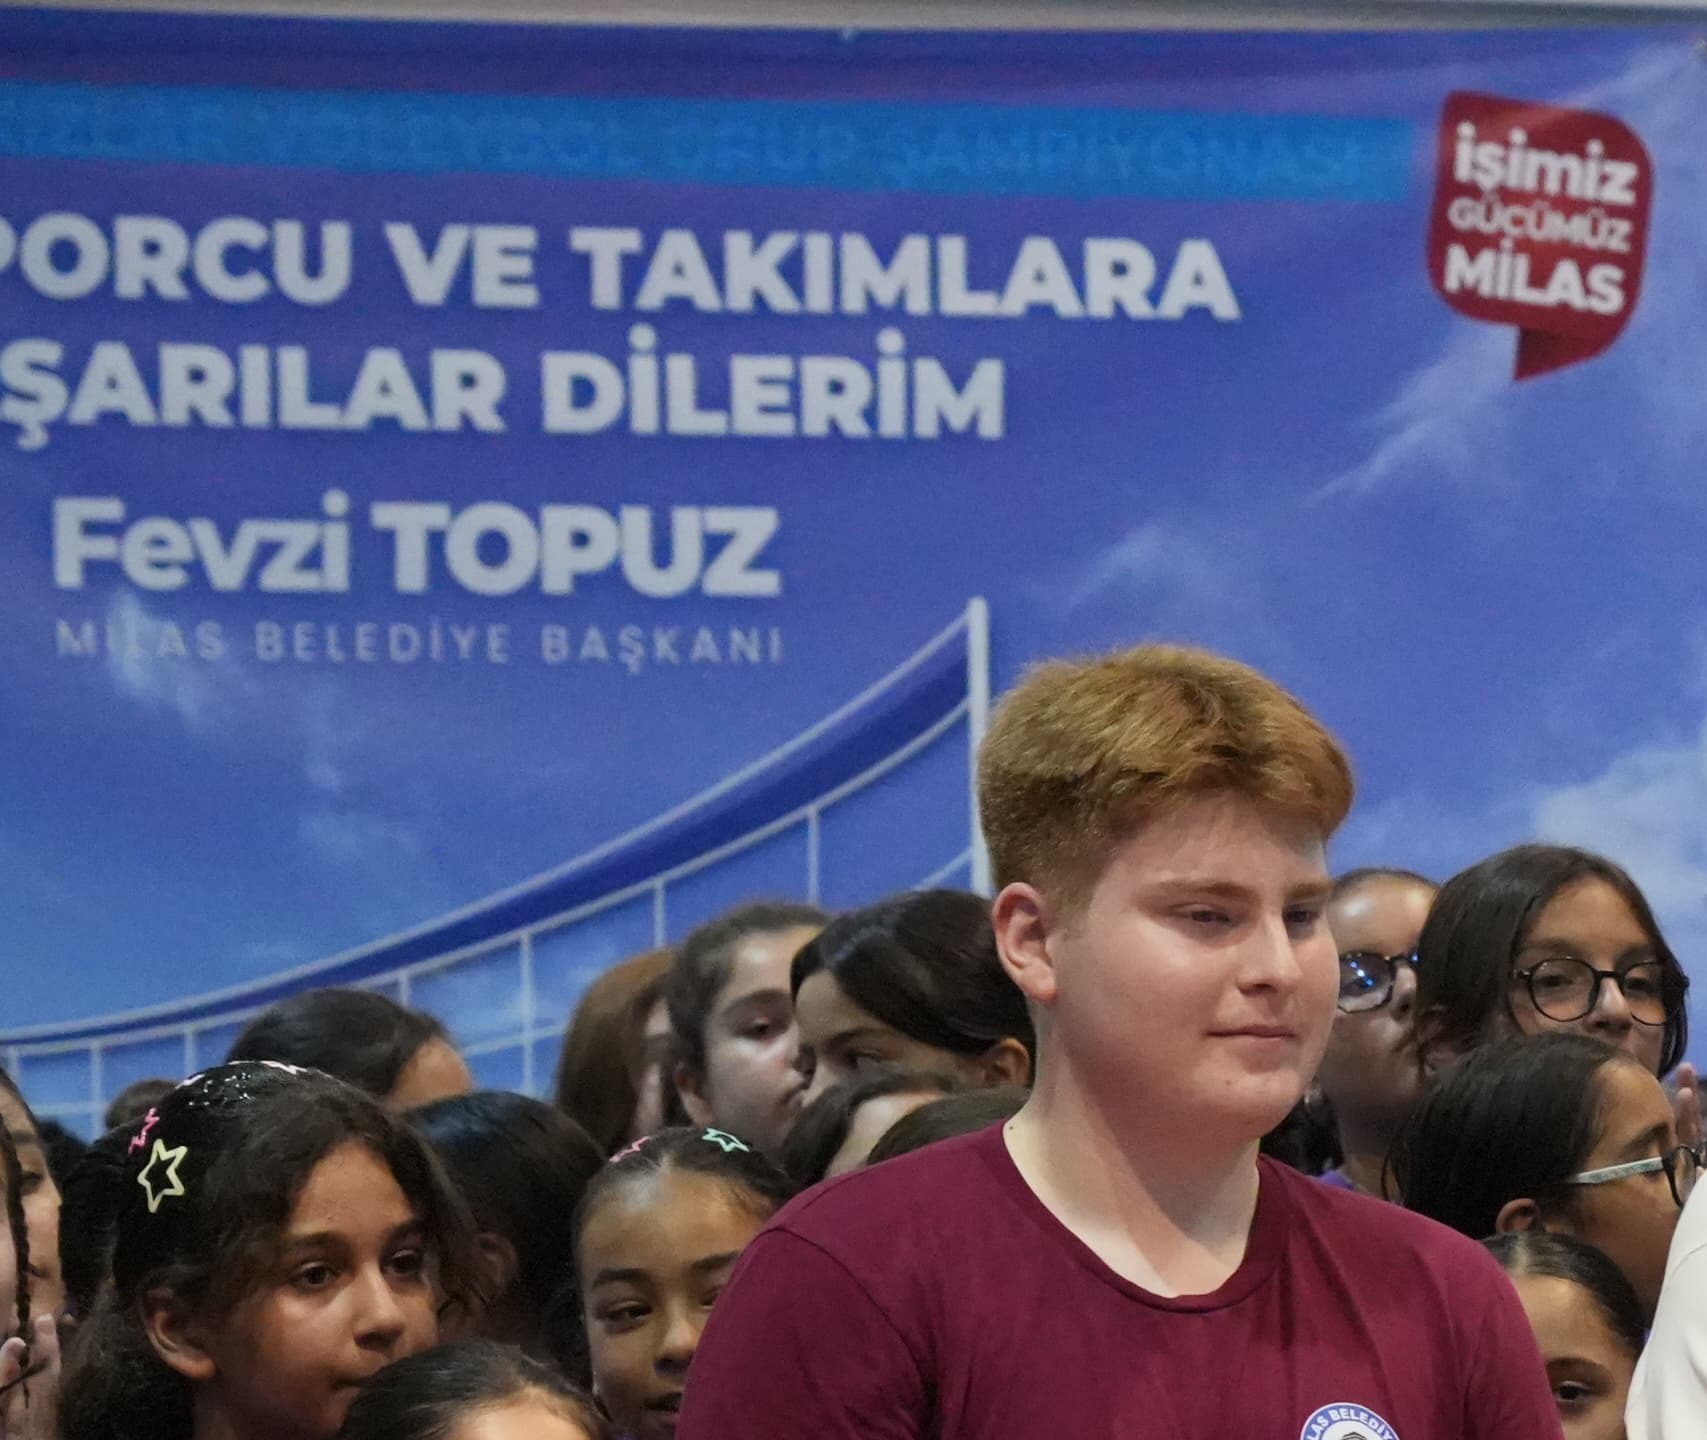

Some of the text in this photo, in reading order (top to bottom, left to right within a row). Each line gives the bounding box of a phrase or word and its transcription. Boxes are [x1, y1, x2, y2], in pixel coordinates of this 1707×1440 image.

[0, 213, 1241, 321] ORCU VE TAKIMLARA
[1443, 236, 1625, 315] MİLAS
[0, 323, 1004, 451] ŞARILAR DİLERİM
[52, 489, 783, 599] Fevzi TOPUZ
[255, 615, 510, 665] BELEDİYE
[540, 624, 783, 676] BAŞKANI
